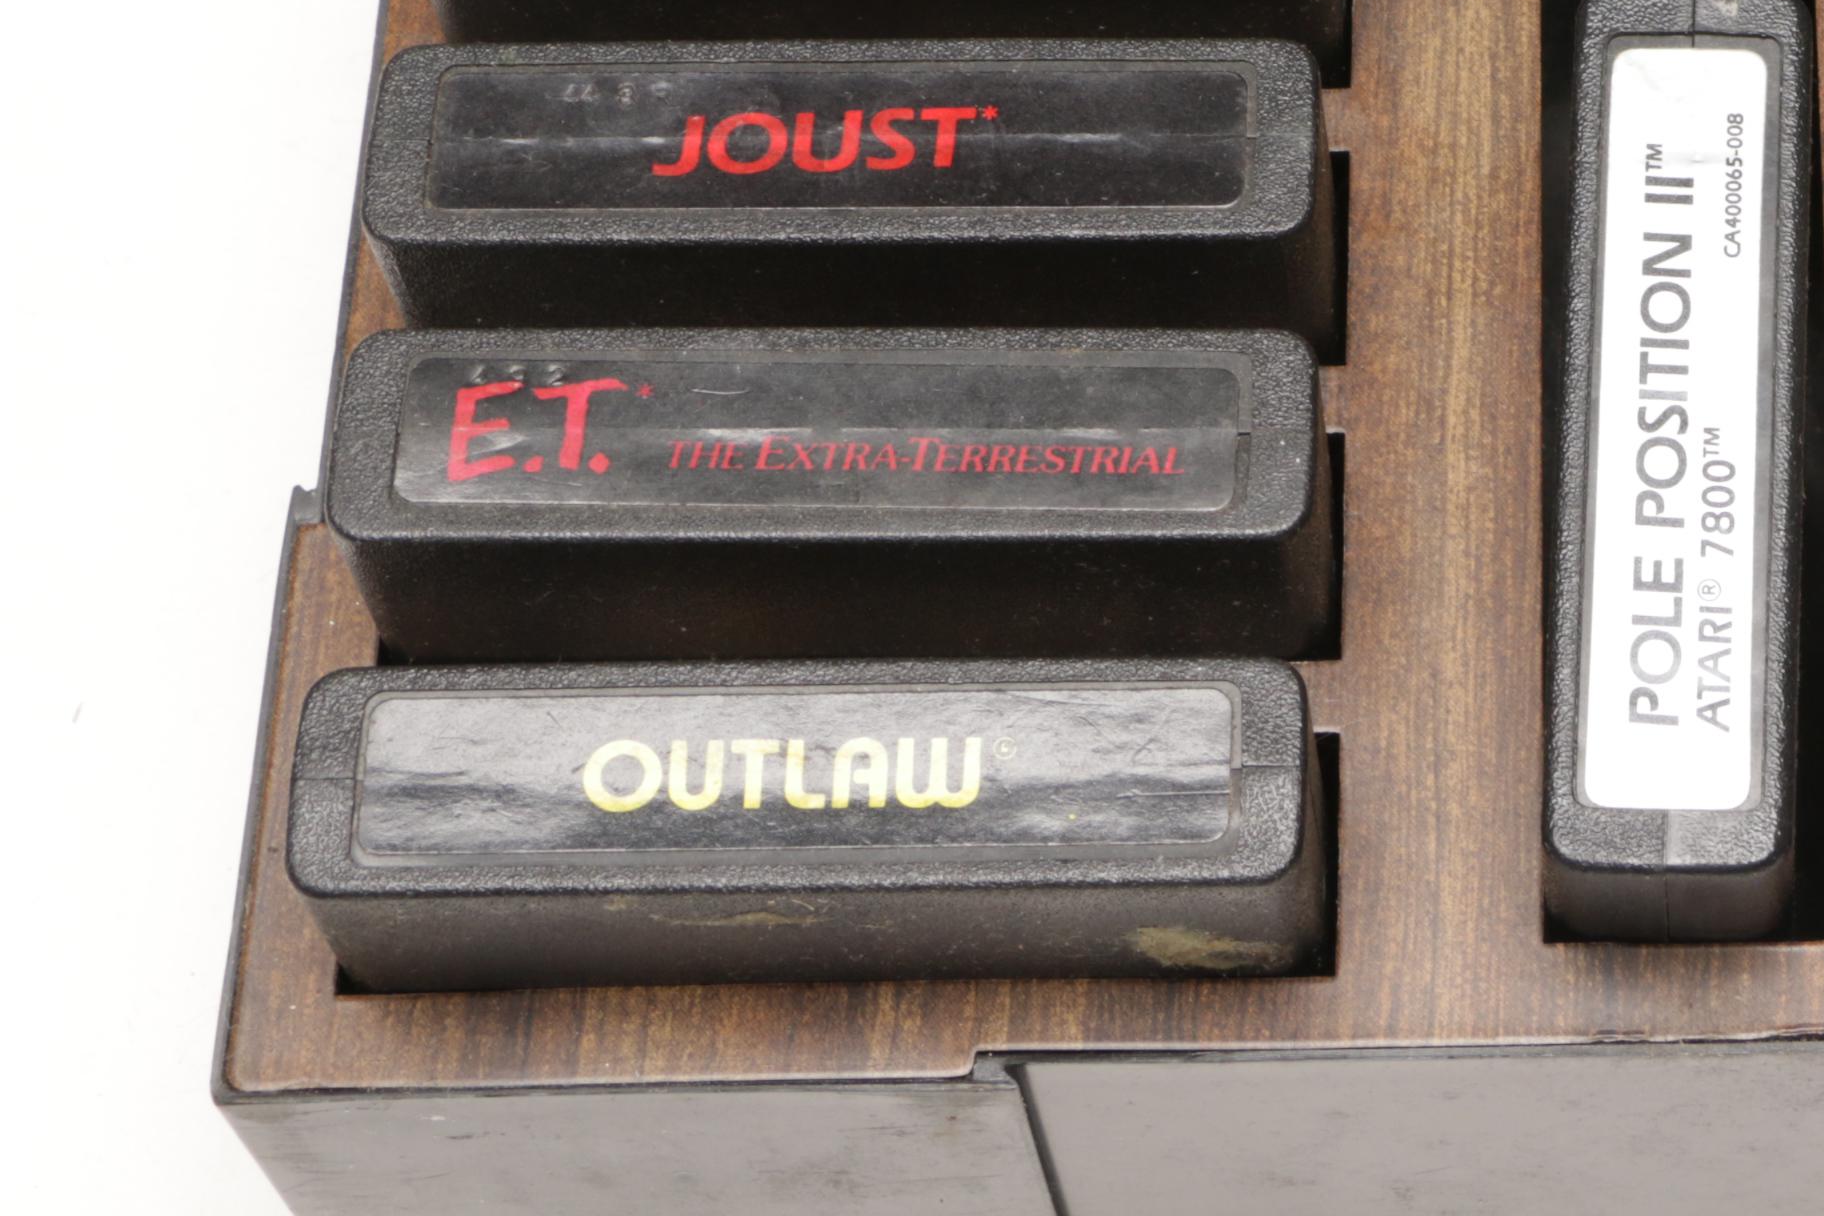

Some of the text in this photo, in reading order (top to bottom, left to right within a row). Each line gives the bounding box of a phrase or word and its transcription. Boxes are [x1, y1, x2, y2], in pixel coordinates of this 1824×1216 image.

[1723, 113, 1744, 258] CA400065-008
[667, 440, 744, 469] THE
[1635, 231, 1693, 528] POSITION
[1628, 555, 1684, 727] POLE
